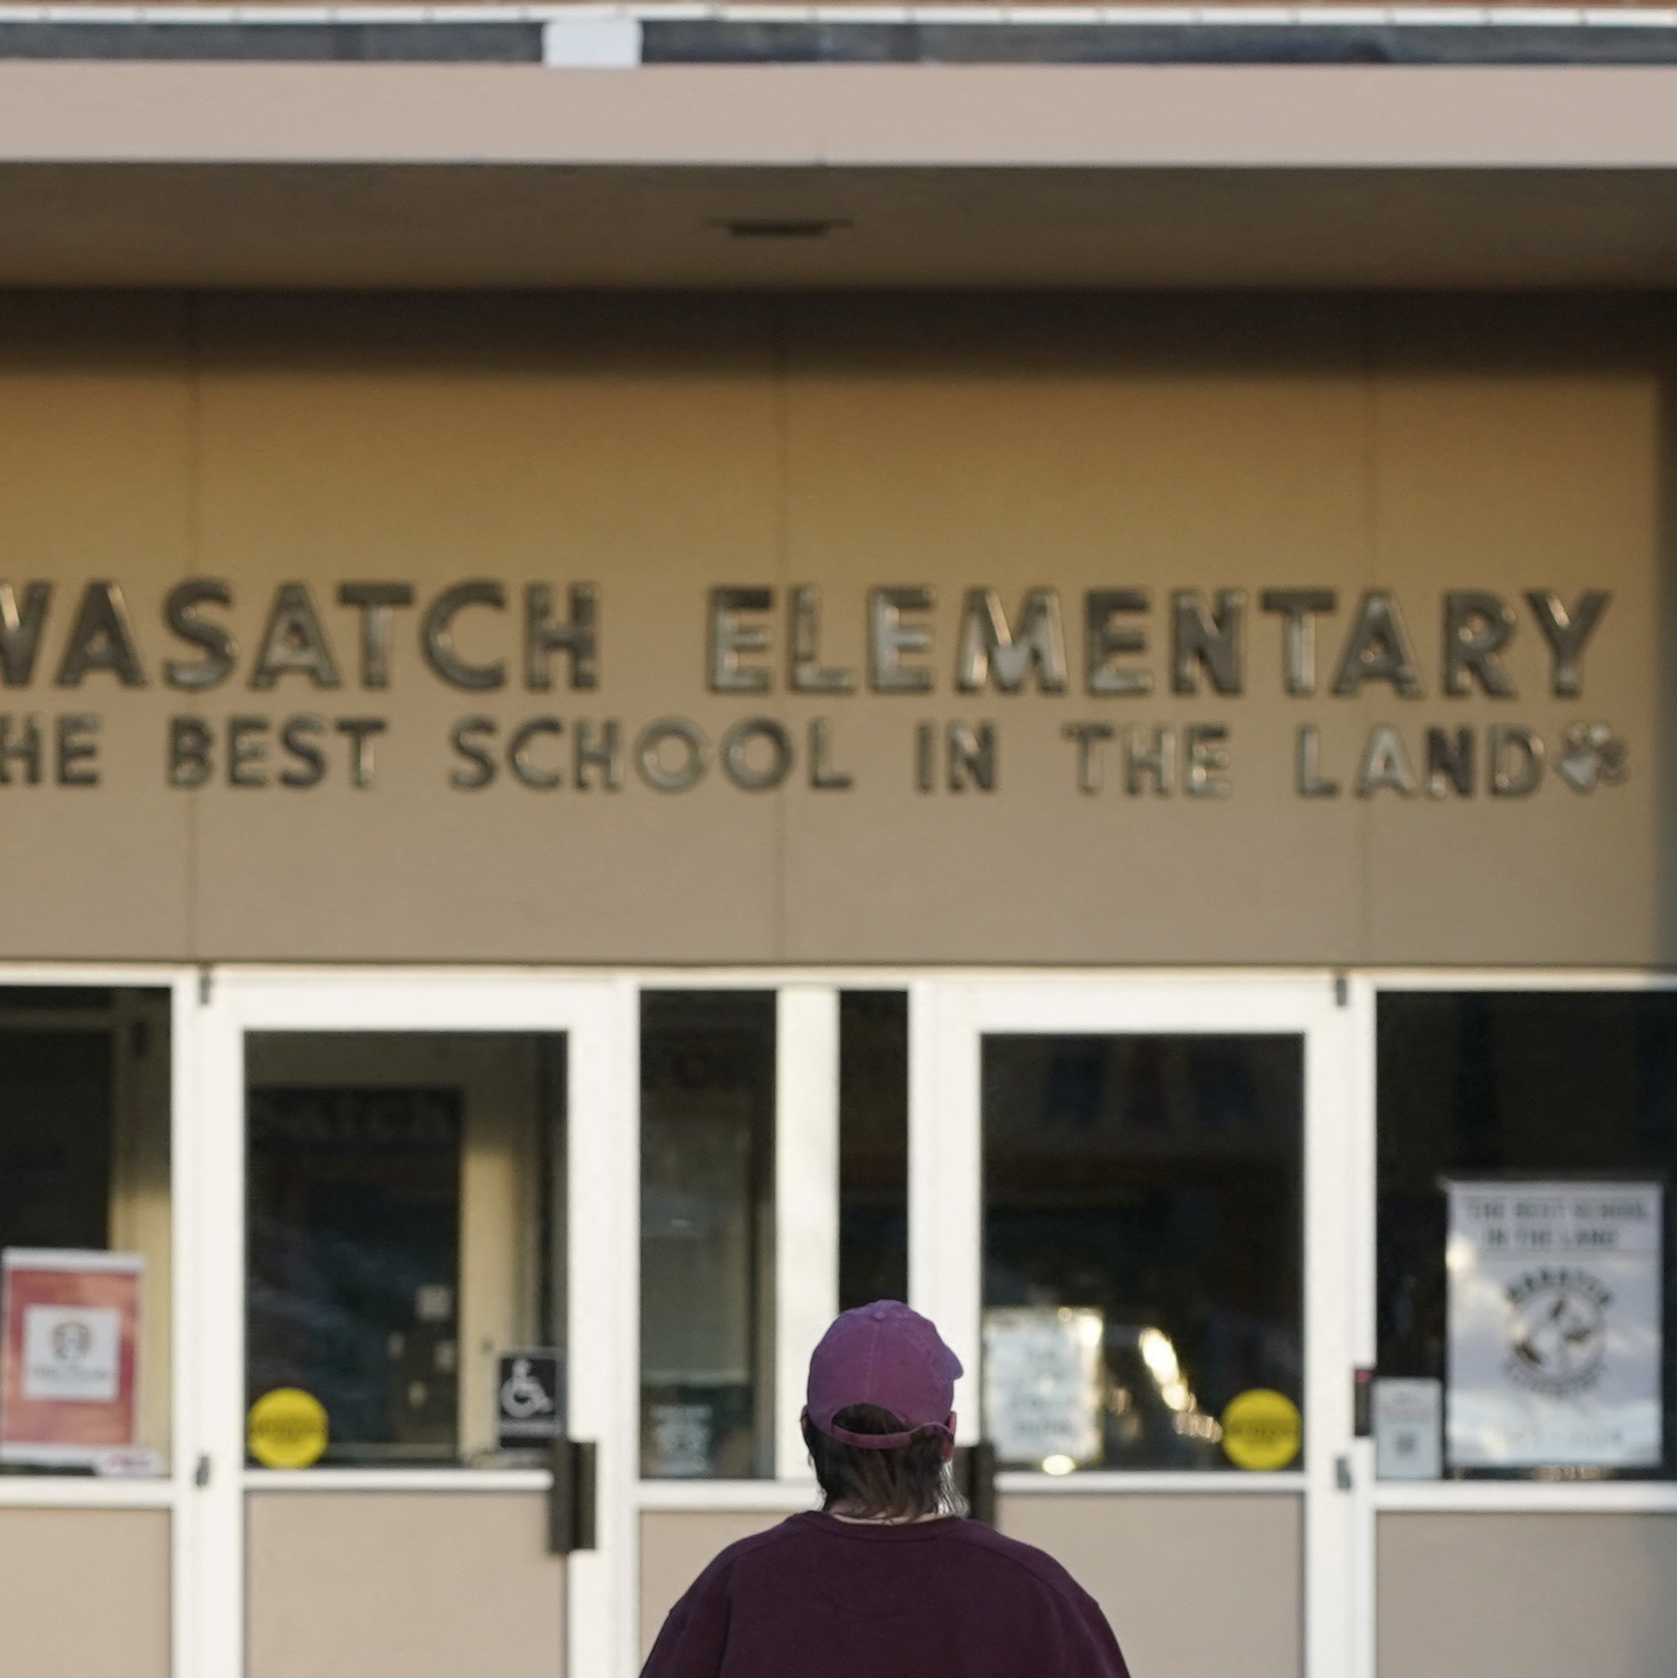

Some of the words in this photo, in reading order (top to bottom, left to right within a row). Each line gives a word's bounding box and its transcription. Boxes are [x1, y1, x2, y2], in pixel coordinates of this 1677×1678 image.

[705, 582, 1614, 700] ELEMENTARY
[167, 711, 385, 795] BEST
[449, 713, 855, 797] SCHOOL
[916, 717, 1000, 797] IN
[1066, 718, 1235, 800] THE
[1293, 719, 1546, 803] LAND
